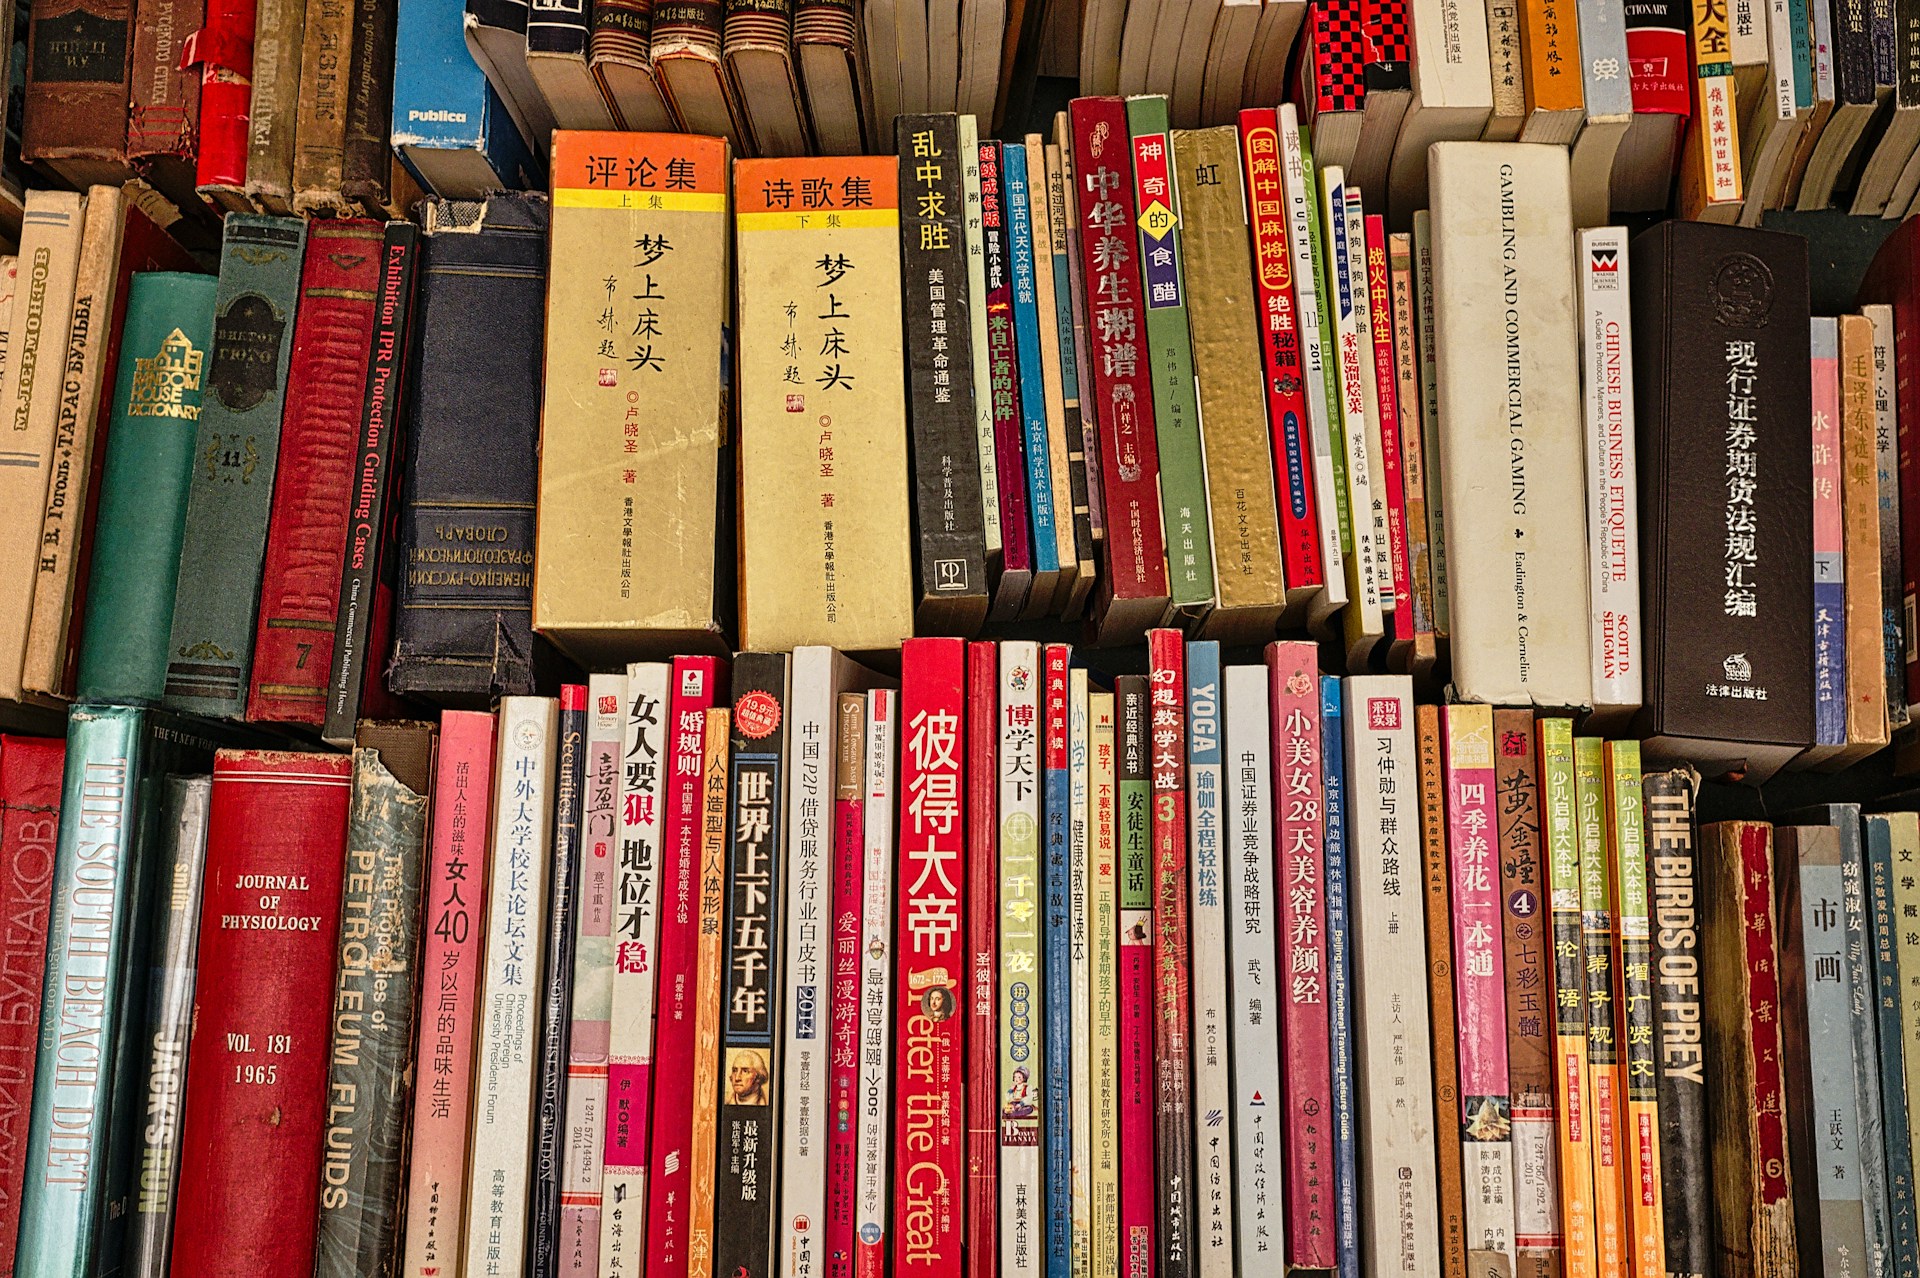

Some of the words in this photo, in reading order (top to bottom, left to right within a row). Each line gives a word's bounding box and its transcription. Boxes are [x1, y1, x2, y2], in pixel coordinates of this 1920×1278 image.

[585, 154, 697, 190] 评论集
[761, 175, 874, 210] 诗歌集
[911, 129, 951, 251] 乱中求胜
[979, 145, 1001, 228] 超级成长版
[1251, 137, 1289, 280] 图解中国麻将经
[1011, 179, 1033, 304] 中国古代天文学成就
[1499, 163, 1518, 262] GAMBLING
[381, 244, 406, 327] Exhibition
[626, 233, 675, 372] 梦上床头
[1085, 165, 1137, 378] 中华养生粥谱
[1503, 265, 1520, 306] AND
[67, 294, 93, 375] БУЛЬБА
[376, 329, 396, 363] IPR
[815, 253, 856, 392] 梦上床头
[928, 268, 951, 404] 美国管理革命通鉴
[1310, 343, 1322, 372] 2011
[1595, 319, 1603, 341] Guide
[1605, 321, 1622, 395] CHINESE
[989, 315, 1014, 422] 来自亡者的信件
[1504, 308, 1524, 435] COMMERCIAL
[58, 380, 81, 449] ТАРАС
[366, 366, 391, 449] Protection
[1607, 400, 1624, 480] BUSINESS
[1029, 419, 1049, 528] 北京科学技术出版社
[1123, 442, 1136, 466] 主编
[1509, 438, 1528, 516] GAMING
[1598, 437, 1606, 467] Culture
[1724, 339, 1759, 619] 现行证券期货法规汇编
[351, 523, 372, 570] Cases
[409, 547, 533, 565] ФРАЗЕОЛОГИЧЕСКИЙ
[435, 525, 508, 543] СЛОВАРЬ
[1434, 509, 1447, 598] 四川人民出版社
[1600, 526, 1608, 560] Republic
[1608, 485, 1627, 582] ETIQUETTE
[351, 578, 361, 602] China
[409, 570, 530, 588] НЕМЕЦКО-РУССКИЙ
[1514, 551, 1527, 611] Eadington
[1601, 571, 1609, 594] China
[344, 602, 358, 650] Commercial
[1602, 610, 1615, 680] SELIGMAN
[1617, 613, 1630, 657] SCOTT
[336, 690, 347, 716] House
[1051, 658, 1064, 750] 经典早早读
[1618, 660, 1630, 676] D.
[1705, 683, 1768, 701] 法律出版社
[675, 709, 704, 778] 婚规则
[1004, 704, 1036, 802] 博学天下
[1125, 693, 1138, 775] 亲近经典丛书
[1191, 682, 1217, 754] YOGA
[80, 756, 127, 830] THE
[450, 761, 470, 858] 活出人生的滋味
[586, 752, 620, 838] 喜盈门
[1377, 736, 1401, 898] 习仲勋与群众路线
[1552, 770, 1572, 879] 少儿启蒙大本书
[1650, 789, 1692, 850] THE
[676, 781, 694, 925] 中国第一本女性婚恋成长小说
[701, 754, 725, 936] 人体造型与人体形象
[907, 708, 959, 957] 彼得大帝
[1050, 811, 1064, 928] 经典寓言故事
[1126, 791, 1145, 893] 安徒生童话
[1196, 769, 1218, 908] 瑜伽全程轻松练
[1240, 749, 1262, 935] 中国证券业竞争战略研究
[1327, 775, 1344, 922] 北京及周边旅游休闲指南
[1583, 792, 1603, 901] 少儿启蒙大本书
[1622, 795, 1643, 906] 少儿启蒙大本书
[67, 840, 120, 960] SOUTH
[235, 874, 310, 891] JOURNAL
[259, 895, 280, 910] OF
[502, 755, 536, 987] 中外大学校长论坛文集
[592, 871, 605, 906] 意千重
[730, 770, 773, 1025] 世界上下五千年
[1460, 782, 1494, 978] 四季养花一本通
[1653, 856, 1697, 949] BIRDS
[1842, 860, 1862, 933] 窈窕淑女
[1898, 848, 1920, 947] 文学概论
[221, 914, 322, 931] PHYSIOLOGY
[332, 849, 376, 1066] PETROLEUM
[1160, 835, 1179, 1026] 自然数之王和分数的封印
[1333, 929, 1344, 963] Beijing
[1387, 911, 1400, 935] 上册
[1872, 861, 1895, 1010] 怀念敬爱的周总理诗选
[833, 911, 858, 1069] 爱丽丝漫游奇境
[975, 952, 991, 1016] 圣彼得堡
[1098, 890, 1111, 1037] 正确引导青春期孩子的早恋
[1335, 963, 1344, 981] and
[1515, 943, 1543, 1038] 七彩玉髓
[1556, 940, 1581, 1009] 论语
[1586, 953, 1613, 1045] 弟子规
[1852, 985, 1866, 1016] Lady
[55, 971, 106, 1090] BEACH
[226, 1032, 256, 1054] VOL.
[266, 1033, 292, 1054] 181
[514, 992, 528, 1048] Proceedings
[673, 1010, 684, 1021] 著
[1249, 997, 1263, 1027] 编著
[1336, 983, 1345, 1029] Peripheral
[1391, 992, 1402, 1025] 主访人
[1626, 962, 1655, 1077] 增广贤文
[234, 1064, 278, 1085] 1965
[488, 1042, 501, 1092] Presidents
[513, 1049, 524, 1064] of
[799, 1050, 811, 1092] 零壹财经
[1206, 1045, 1218, 1067] 主编
[1337, 1029, 1347, 1074] Traveling
[1392, 1034, 1404, 1066] 严宏伟
[1660, 1002, 1704, 1086] PREY
[486, 1093, 498, 1125] Forum
[1100, 1047, 1112, 1140] 宏章家庭教育研究所
[1339, 1075, 1348, 1111] Leisure
[1341, 1112, 1349, 1141] Guide
[45, 1103, 95, 1192] DIET
[322, 1082, 356, 1211] FLUIDS
[572, 1126, 583, 1150] 2014
[582, 1104, 595, 1184] 247.57/14494.2
[616, 1123, 630, 1149] 编著
[740, 1119, 760, 1202] 最新升级版
[1100, 1149, 1111, 1171] 主编
[1480, 1150, 1491, 1177] 陈涛
[1524, 1161, 1534, 1185] 2015
[1481, 1185, 1493, 1205] 编著
[1493, 1185, 1504, 1205] 主编
[1534, 1142, 1547, 1216] 247.56/1292.4
[486, 1168, 506, 1277] 高等教育出版社
[1015, 1183, 1028, 1268] 吉林美术出版社
[1105, 1182, 1116, 1277] 首都师范大学出版社
[1404, 1181, 1416, 1272] 中共中央党校出版社
